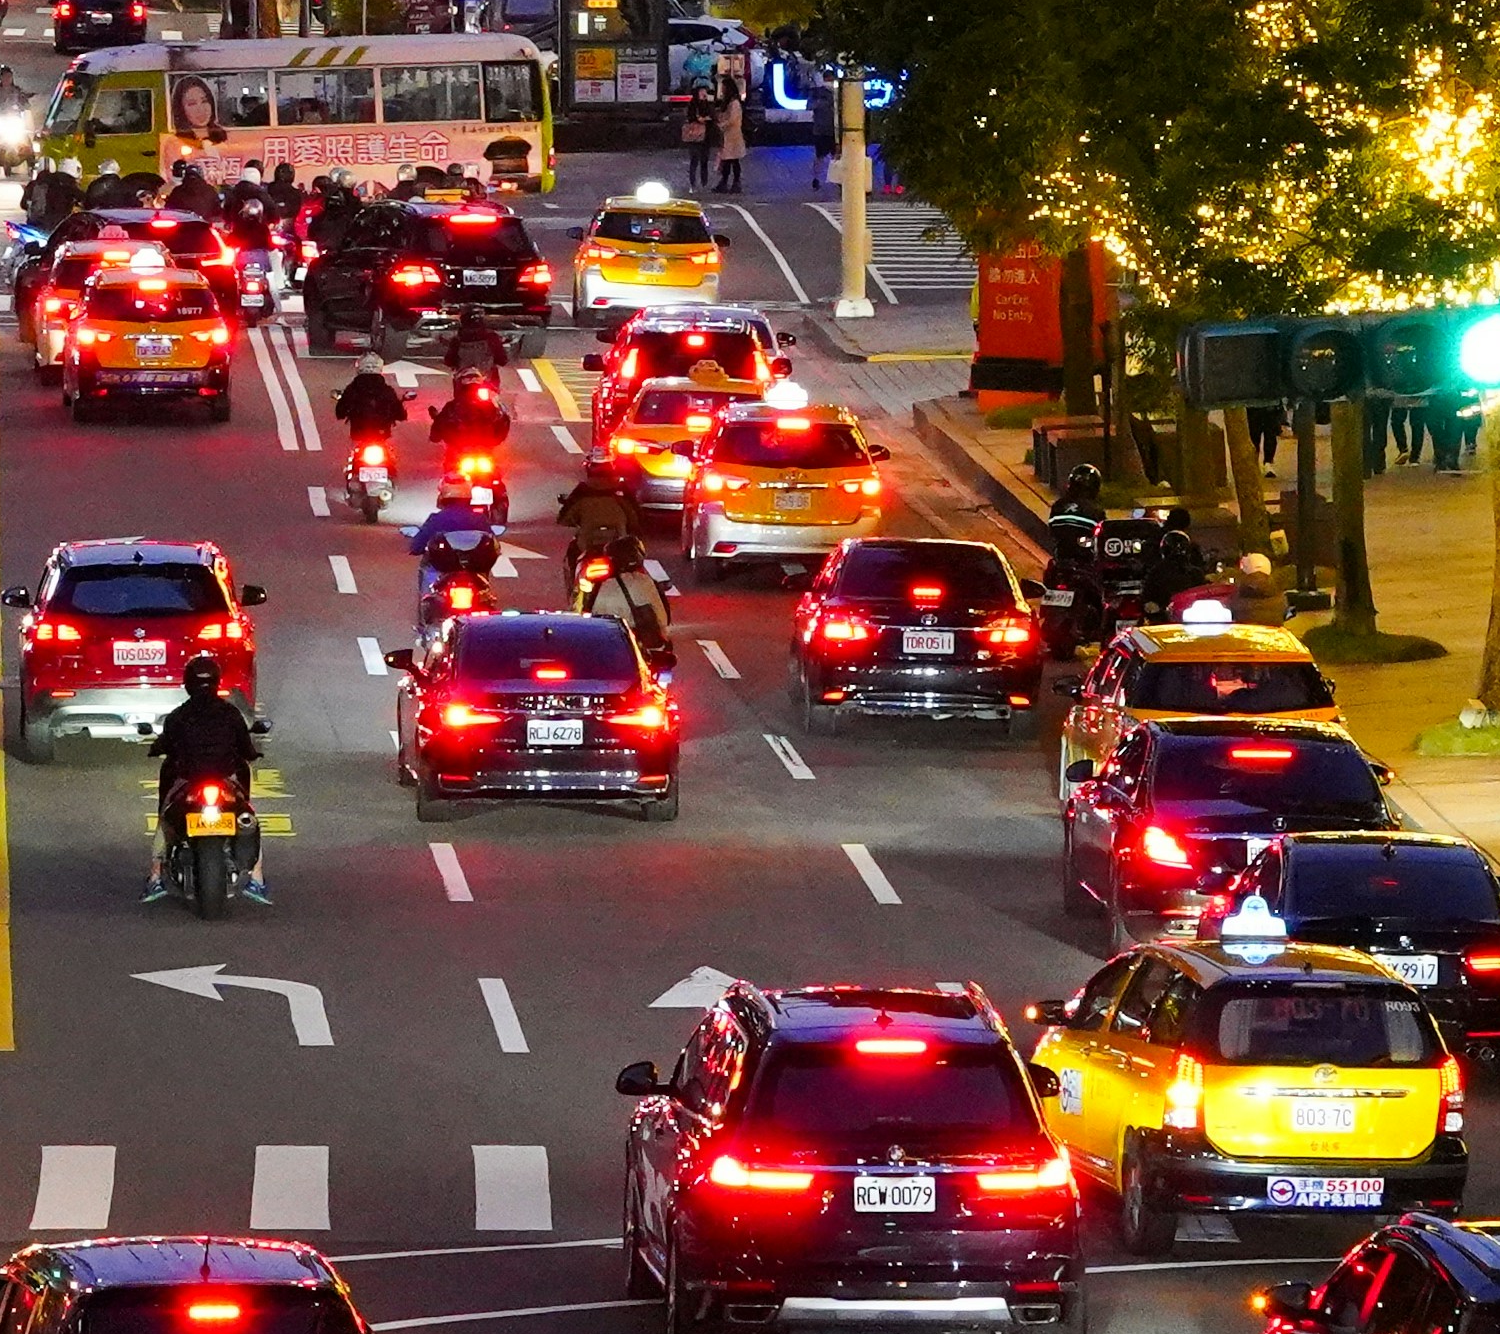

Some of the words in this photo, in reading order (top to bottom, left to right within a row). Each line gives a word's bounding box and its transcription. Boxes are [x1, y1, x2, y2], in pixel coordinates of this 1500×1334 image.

[262, 131, 451, 167] 用愛照護生命
[1385, 1001, 1421, 1013] 8093
[1326, 1179, 1383, 1193] 55100
